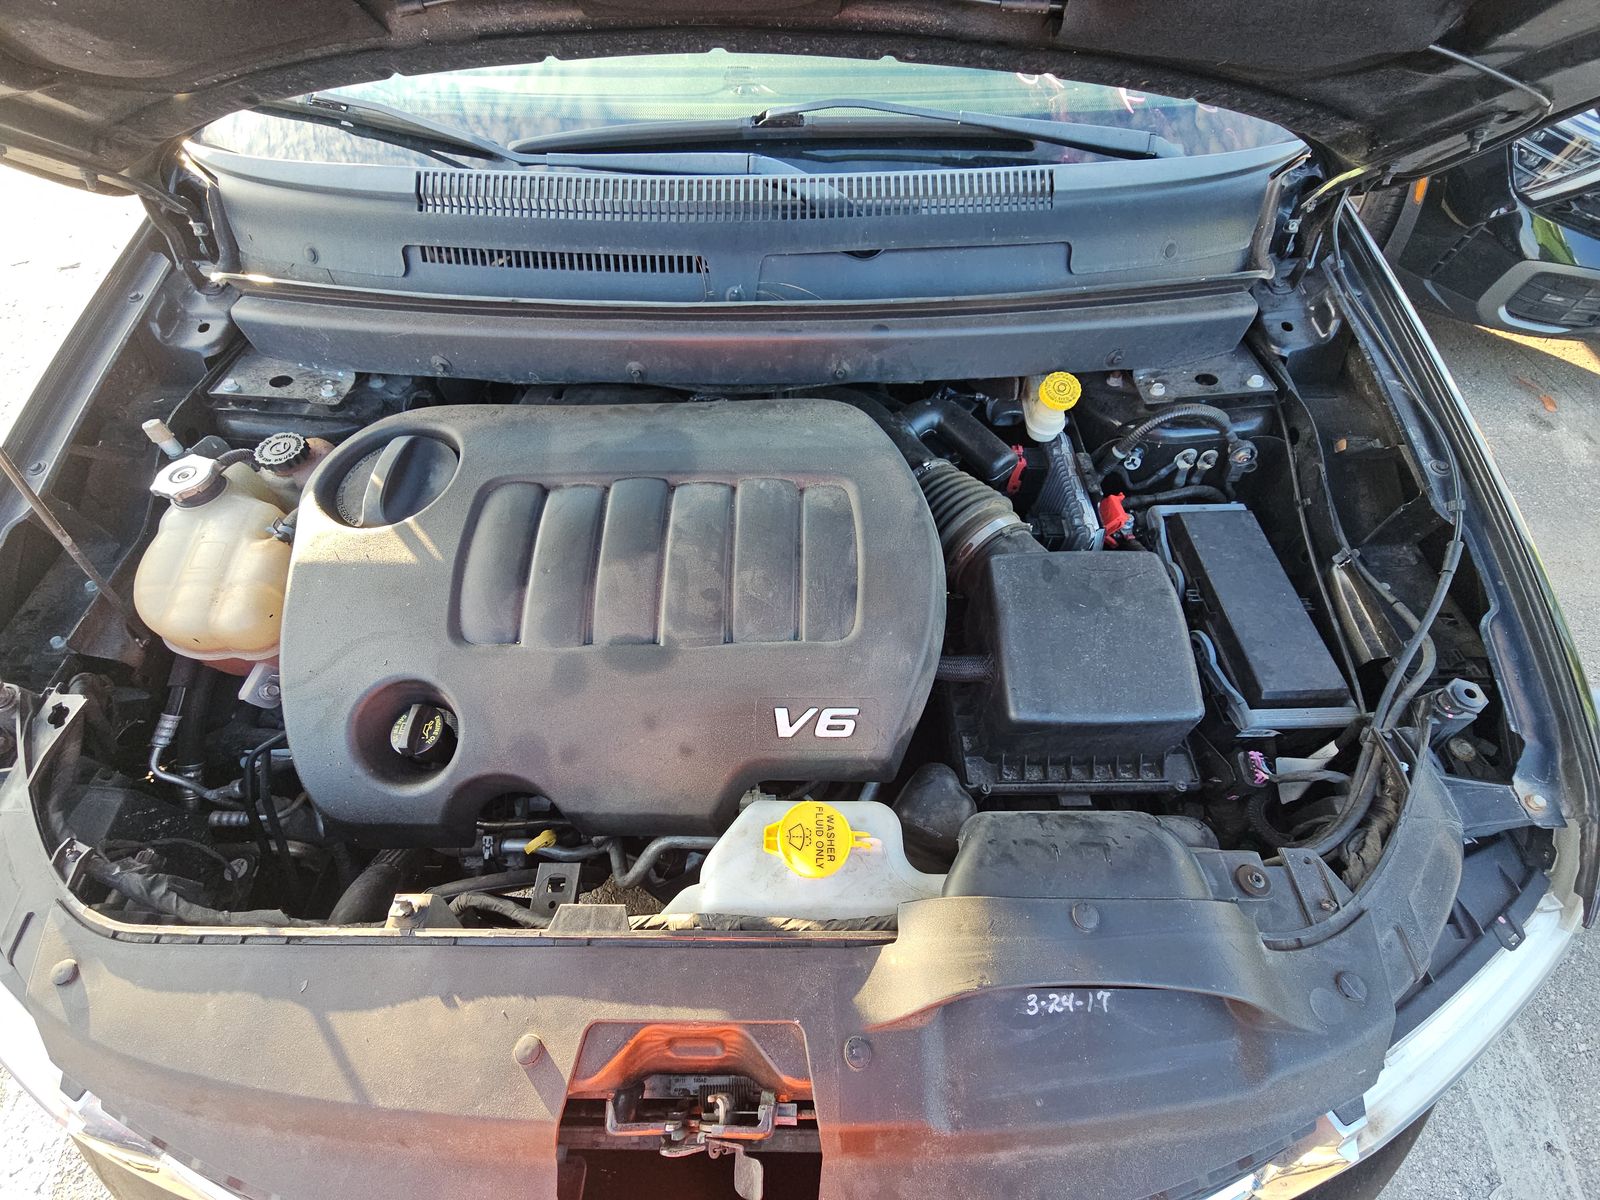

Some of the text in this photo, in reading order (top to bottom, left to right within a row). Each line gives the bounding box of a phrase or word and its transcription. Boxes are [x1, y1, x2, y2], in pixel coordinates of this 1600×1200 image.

[425, 736, 435, 744] OIL
[774, 707, 860, 738] V6
[815, 806, 825, 869] FLUID ONLY
[826, 814, 836, 862] WASHER
